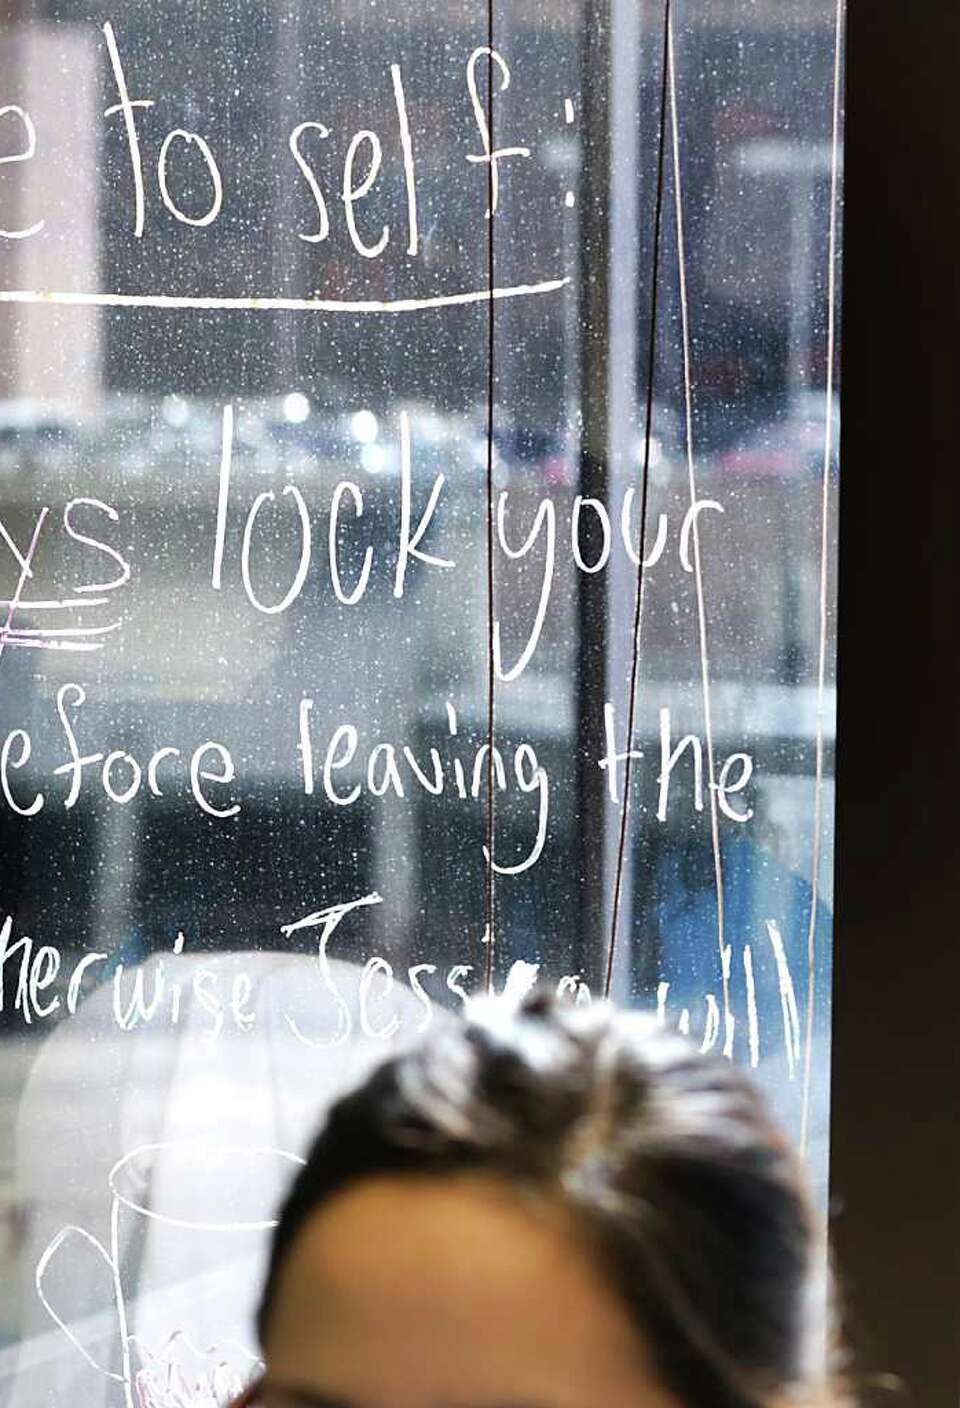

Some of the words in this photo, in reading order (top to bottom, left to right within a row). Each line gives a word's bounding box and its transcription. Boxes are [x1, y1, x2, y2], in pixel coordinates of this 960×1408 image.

[102, 22, 222, 237] to
[289, 46, 575, 258] self:
[212, 404, 456, 614] lock
[495, 487, 725, 682] your
[297, 699, 549, 875] leaving
[597, 702, 754, 821] the
